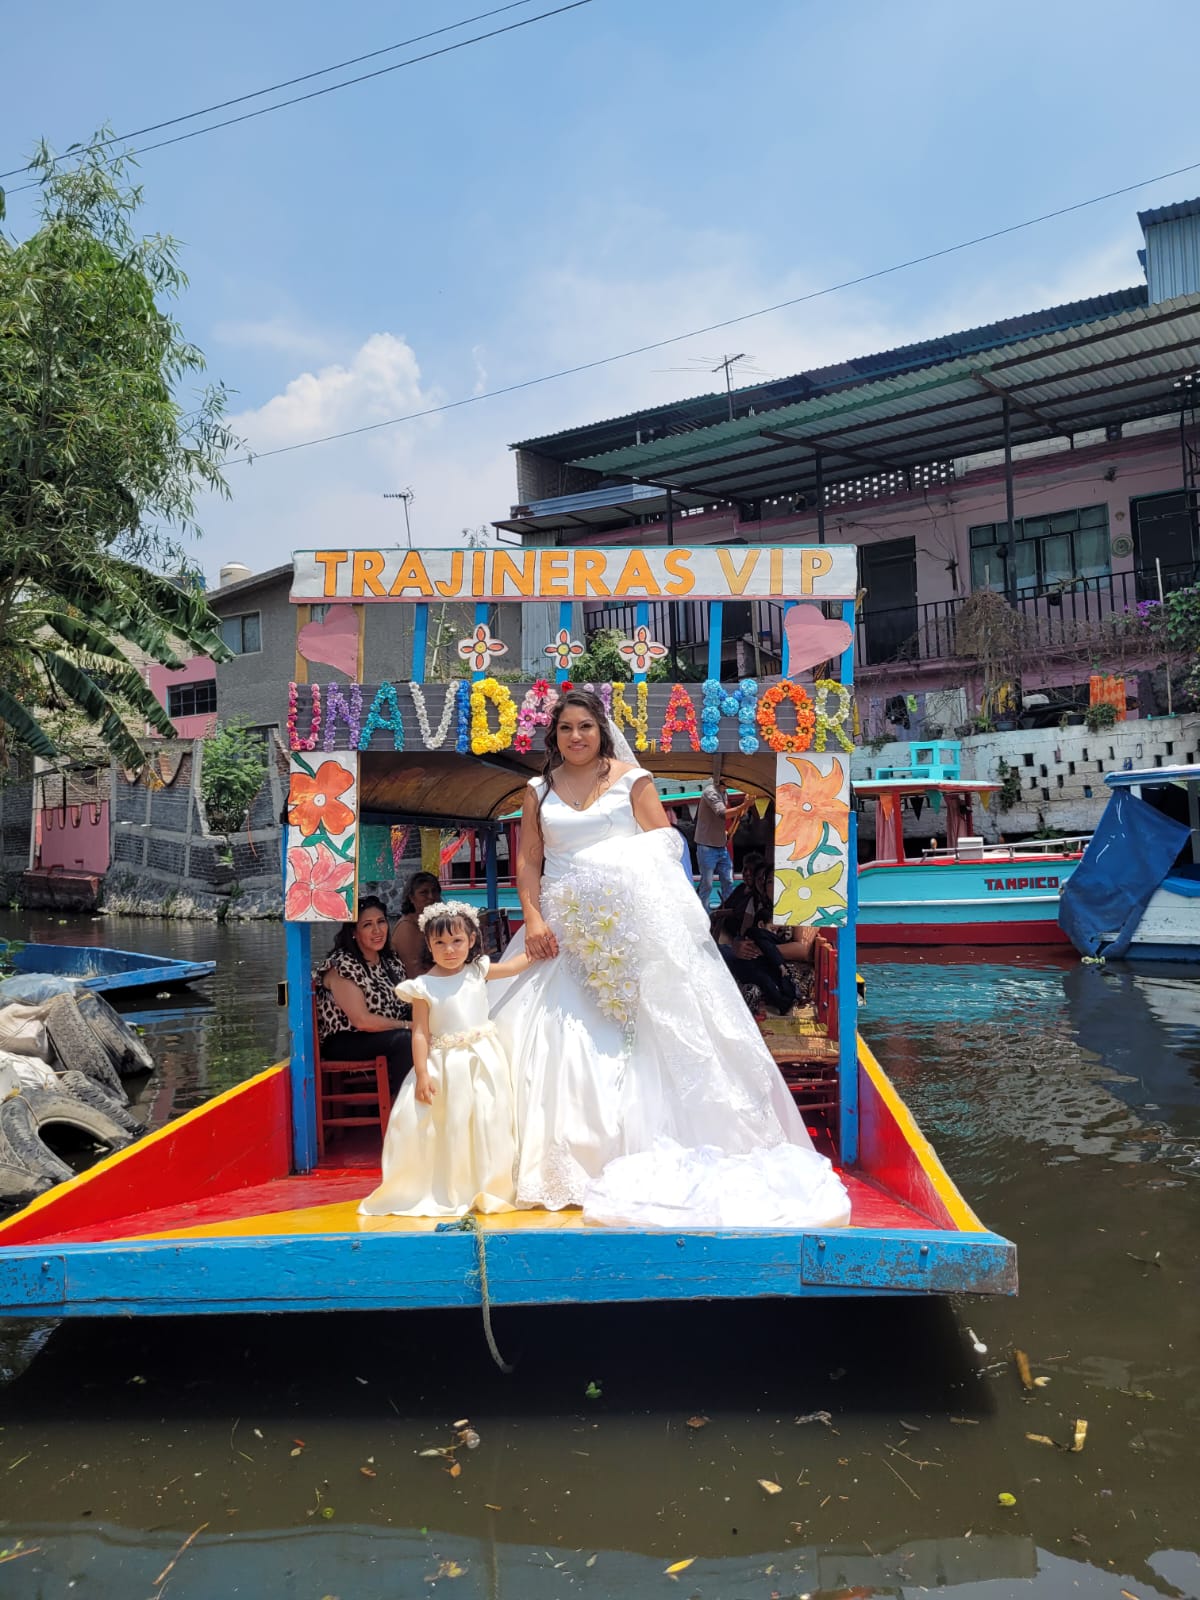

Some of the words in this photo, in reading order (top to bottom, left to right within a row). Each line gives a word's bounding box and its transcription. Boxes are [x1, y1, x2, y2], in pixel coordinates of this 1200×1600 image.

[315, 548, 696, 597] TRAJINERAS
[715, 548, 834, 595] VIP
[287, 681, 405, 752] UNA
[660, 678, 856, 755] AMOR
[984, 876, 1059, 891] TAMPICO
